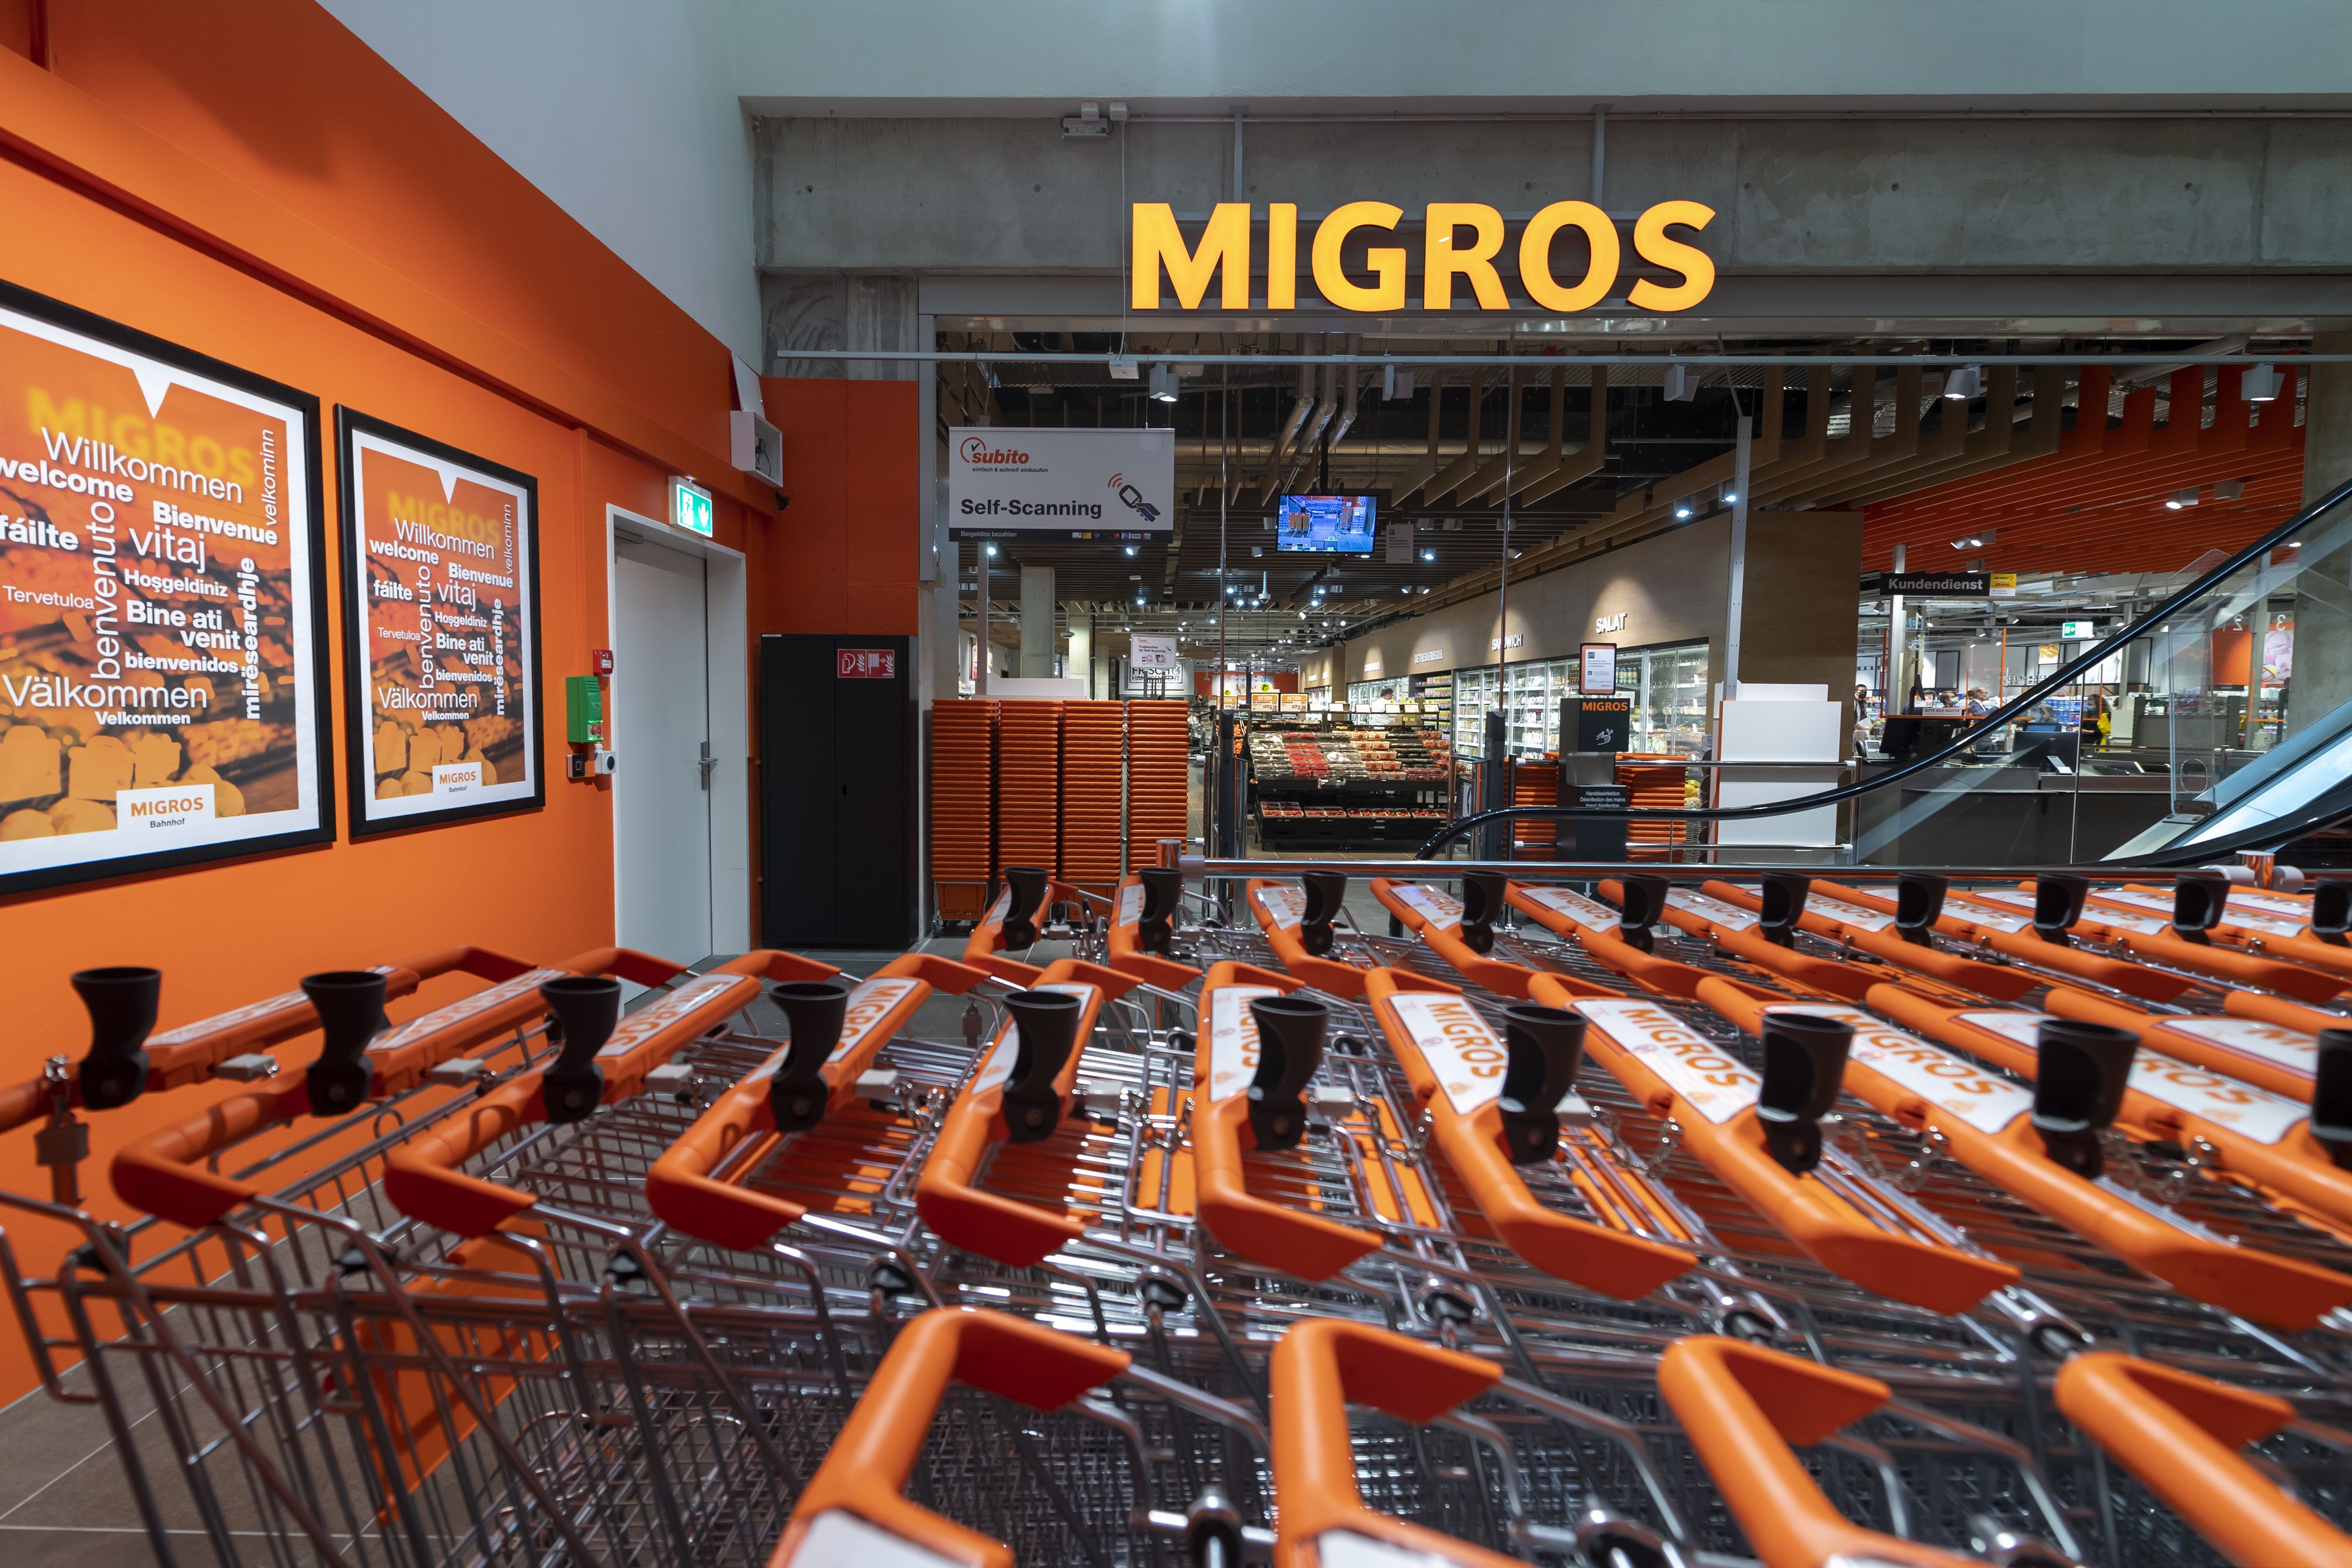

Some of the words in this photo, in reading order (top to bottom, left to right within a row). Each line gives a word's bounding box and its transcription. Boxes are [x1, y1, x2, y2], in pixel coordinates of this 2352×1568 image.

[1131, 200, 1717, 312] MIGROS
[26, 384, 256, 488] MIGROS
[41, 427, 242, 504] Willkommen
[972, 449, 1029, 464] subito
[0, 457, 133, 502] welcome
[259, 429, 277, 526] velkominn
[153, 500, 278, 546] Bienvenue
[387, 490, 500, 548] MIGROS
[961, 499, 1102, 519] Self-Scanning
[0, 514, 79, 551] fáilte
[395, 517, 495, 560] Willkommen
[503, 504, 513, 574] velkominn
[129, 526, 206, 574] vitaj
[369, 539, 439, 565] welcome
[125, 569, 228, 598] Hoşgeldiniz
[449, 562, 513, 589] Bienvenue
[1889, 578, 1983, 590] Kundendienst
[2, 586, 95, 609] Tervetuloa
[86, 502, 121, 680] benvenuto
[373, 580, 413, 601] fáilte
[437, 580, 476, 612] vitaj
[126, 600, 186, 627] Bine
[193, 610, 222, 630] ati
[416, 566, 434, 689] benvenuto
[435, 611, 487, 628] Hoşgeldiniz
[1596, 613, 1627, 634] SALAT
[180, 628, 241, 650] venit
[236, 557, 260, 719] mirëseardhje
[377, 627, 420, 641] Tervetuloa
[436, 633, 466, 651] Bine
[469, 637, 485, 652] ati
[125, 652, 238, 674] bienvenidos
[463, 651, 494, 666] venit
[492, 598, 505, 716] mirëseardhje
[436, 670, 493, 683] bienvenidos
[1, 674, 208, 708] Välkommen
[378, 687, 477, 709] Välkommen
[95, 711, 191, 725] Velkommen
[422, 711, 469, 721] Velkommen
[1582, 701, 1628, 711] MIGROS
[439, 771, 476, 784] MIGROS
[131, 797, 204, 817] MIGROS
[150, 818, 185, 828] Bahnhof
[1548, 891, 1623, 920] MIGROS
[1426, 1003, 1508, 1078] MIGROS
[1618, 1009, 1758, 1086] MIGROS
